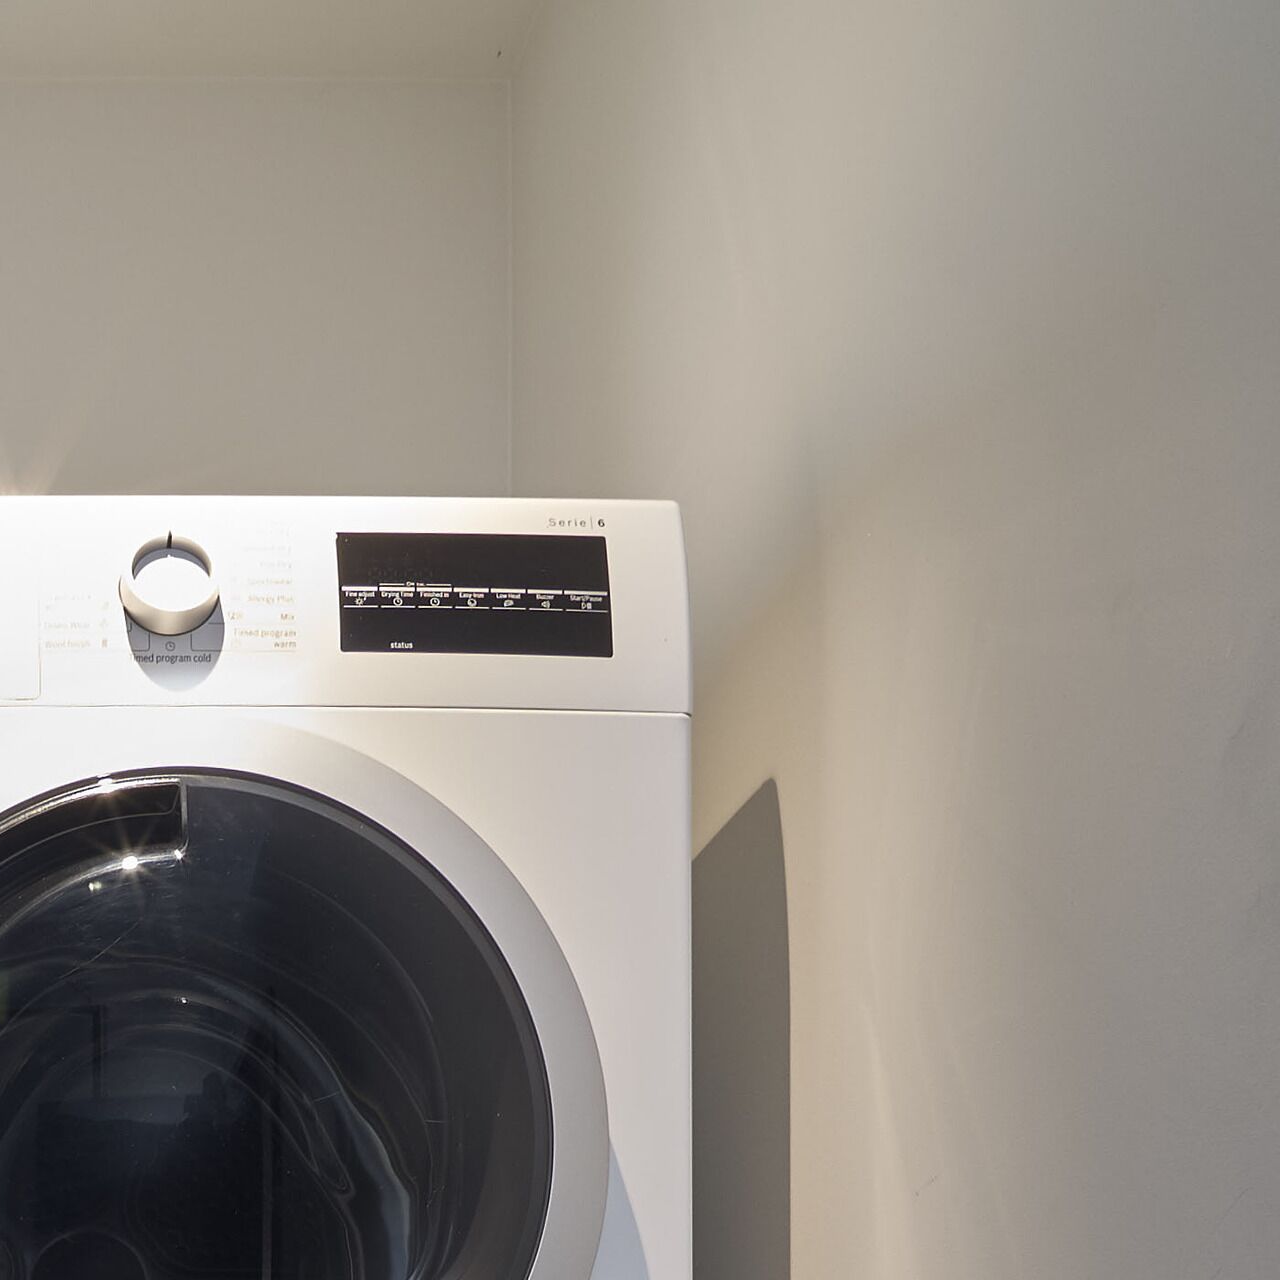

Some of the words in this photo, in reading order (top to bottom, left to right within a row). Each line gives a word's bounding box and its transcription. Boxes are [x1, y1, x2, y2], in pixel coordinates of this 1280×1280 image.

[548, 518, 586, 528] Serie
[597, 518, 605, 528] 6
[390, 641, 413, 649] status
[156, 655, 192, 665] program
[193, 653, 211, 663] cold
